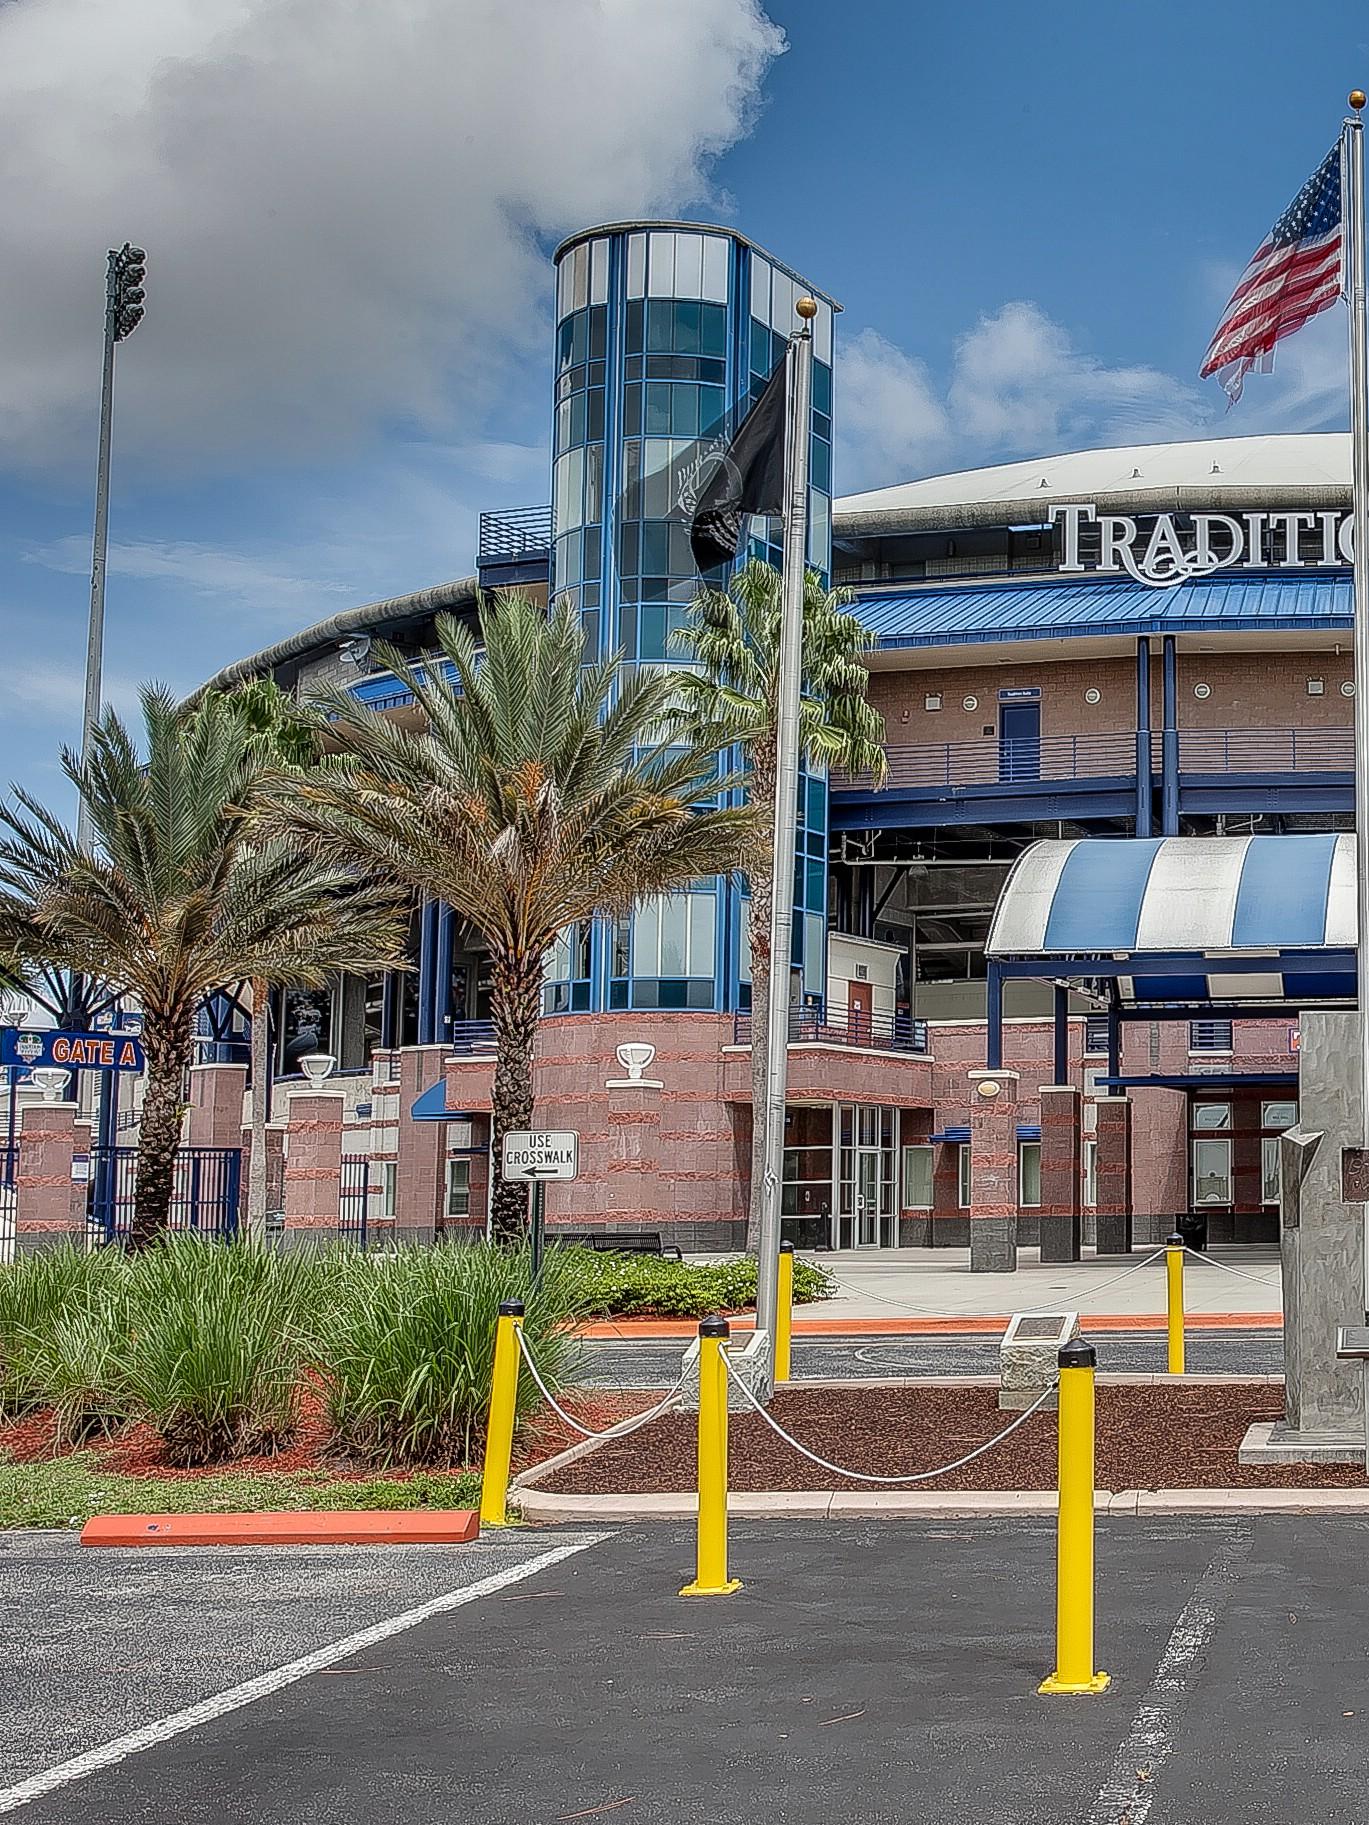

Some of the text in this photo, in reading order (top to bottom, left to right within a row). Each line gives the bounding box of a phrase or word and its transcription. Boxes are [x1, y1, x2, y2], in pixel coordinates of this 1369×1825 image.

[52, 1037, 115, 1065] GATE
[119, 1041, 137, 1066] A
[529, 1134, 552, 1148] USE
[506, 1150, 573, 1165] CROSSWALK
